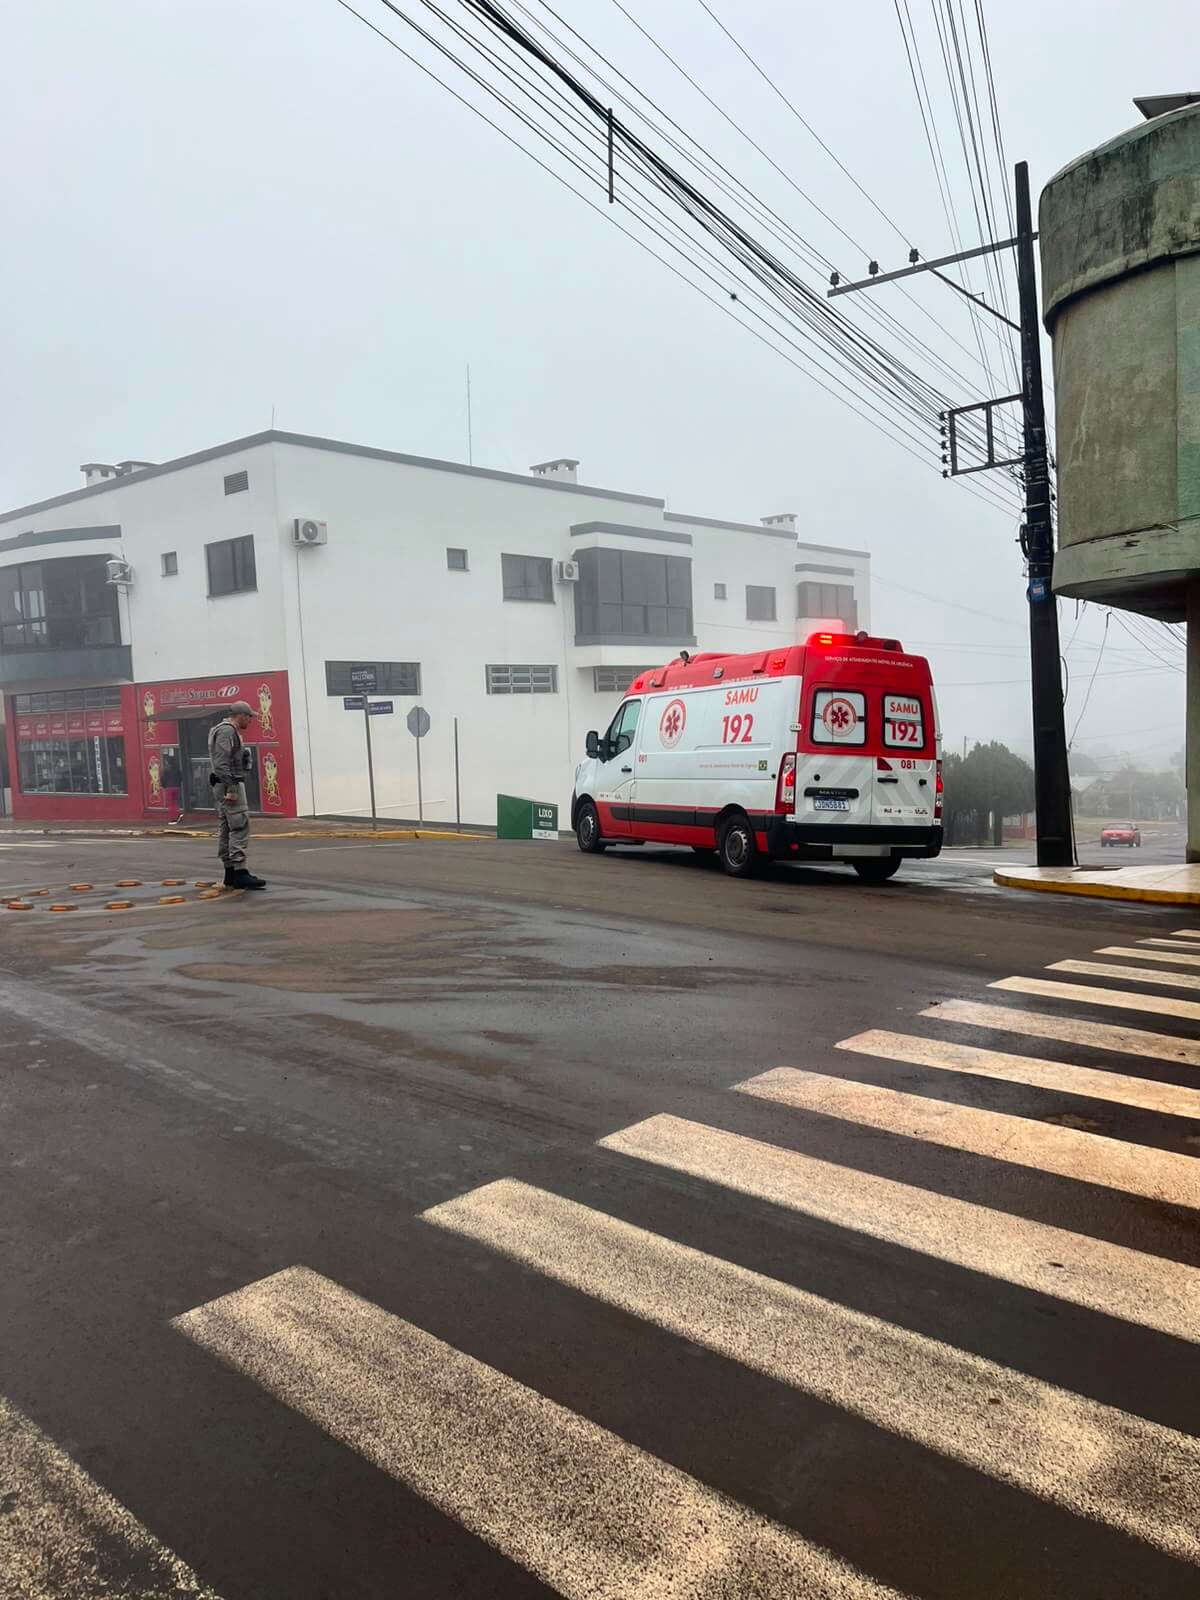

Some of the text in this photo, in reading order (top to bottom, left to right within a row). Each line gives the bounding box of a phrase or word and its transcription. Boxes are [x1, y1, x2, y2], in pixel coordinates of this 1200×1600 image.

[725, 688, 759, 706] SAMU
[890, 702, 918, 714] SAMU
[722, 713, 754, 744] 192
[890, 720, 918, 742] 192
[900, 760, 916, 769] 081
[538, 807, 553, 819] LIXO
